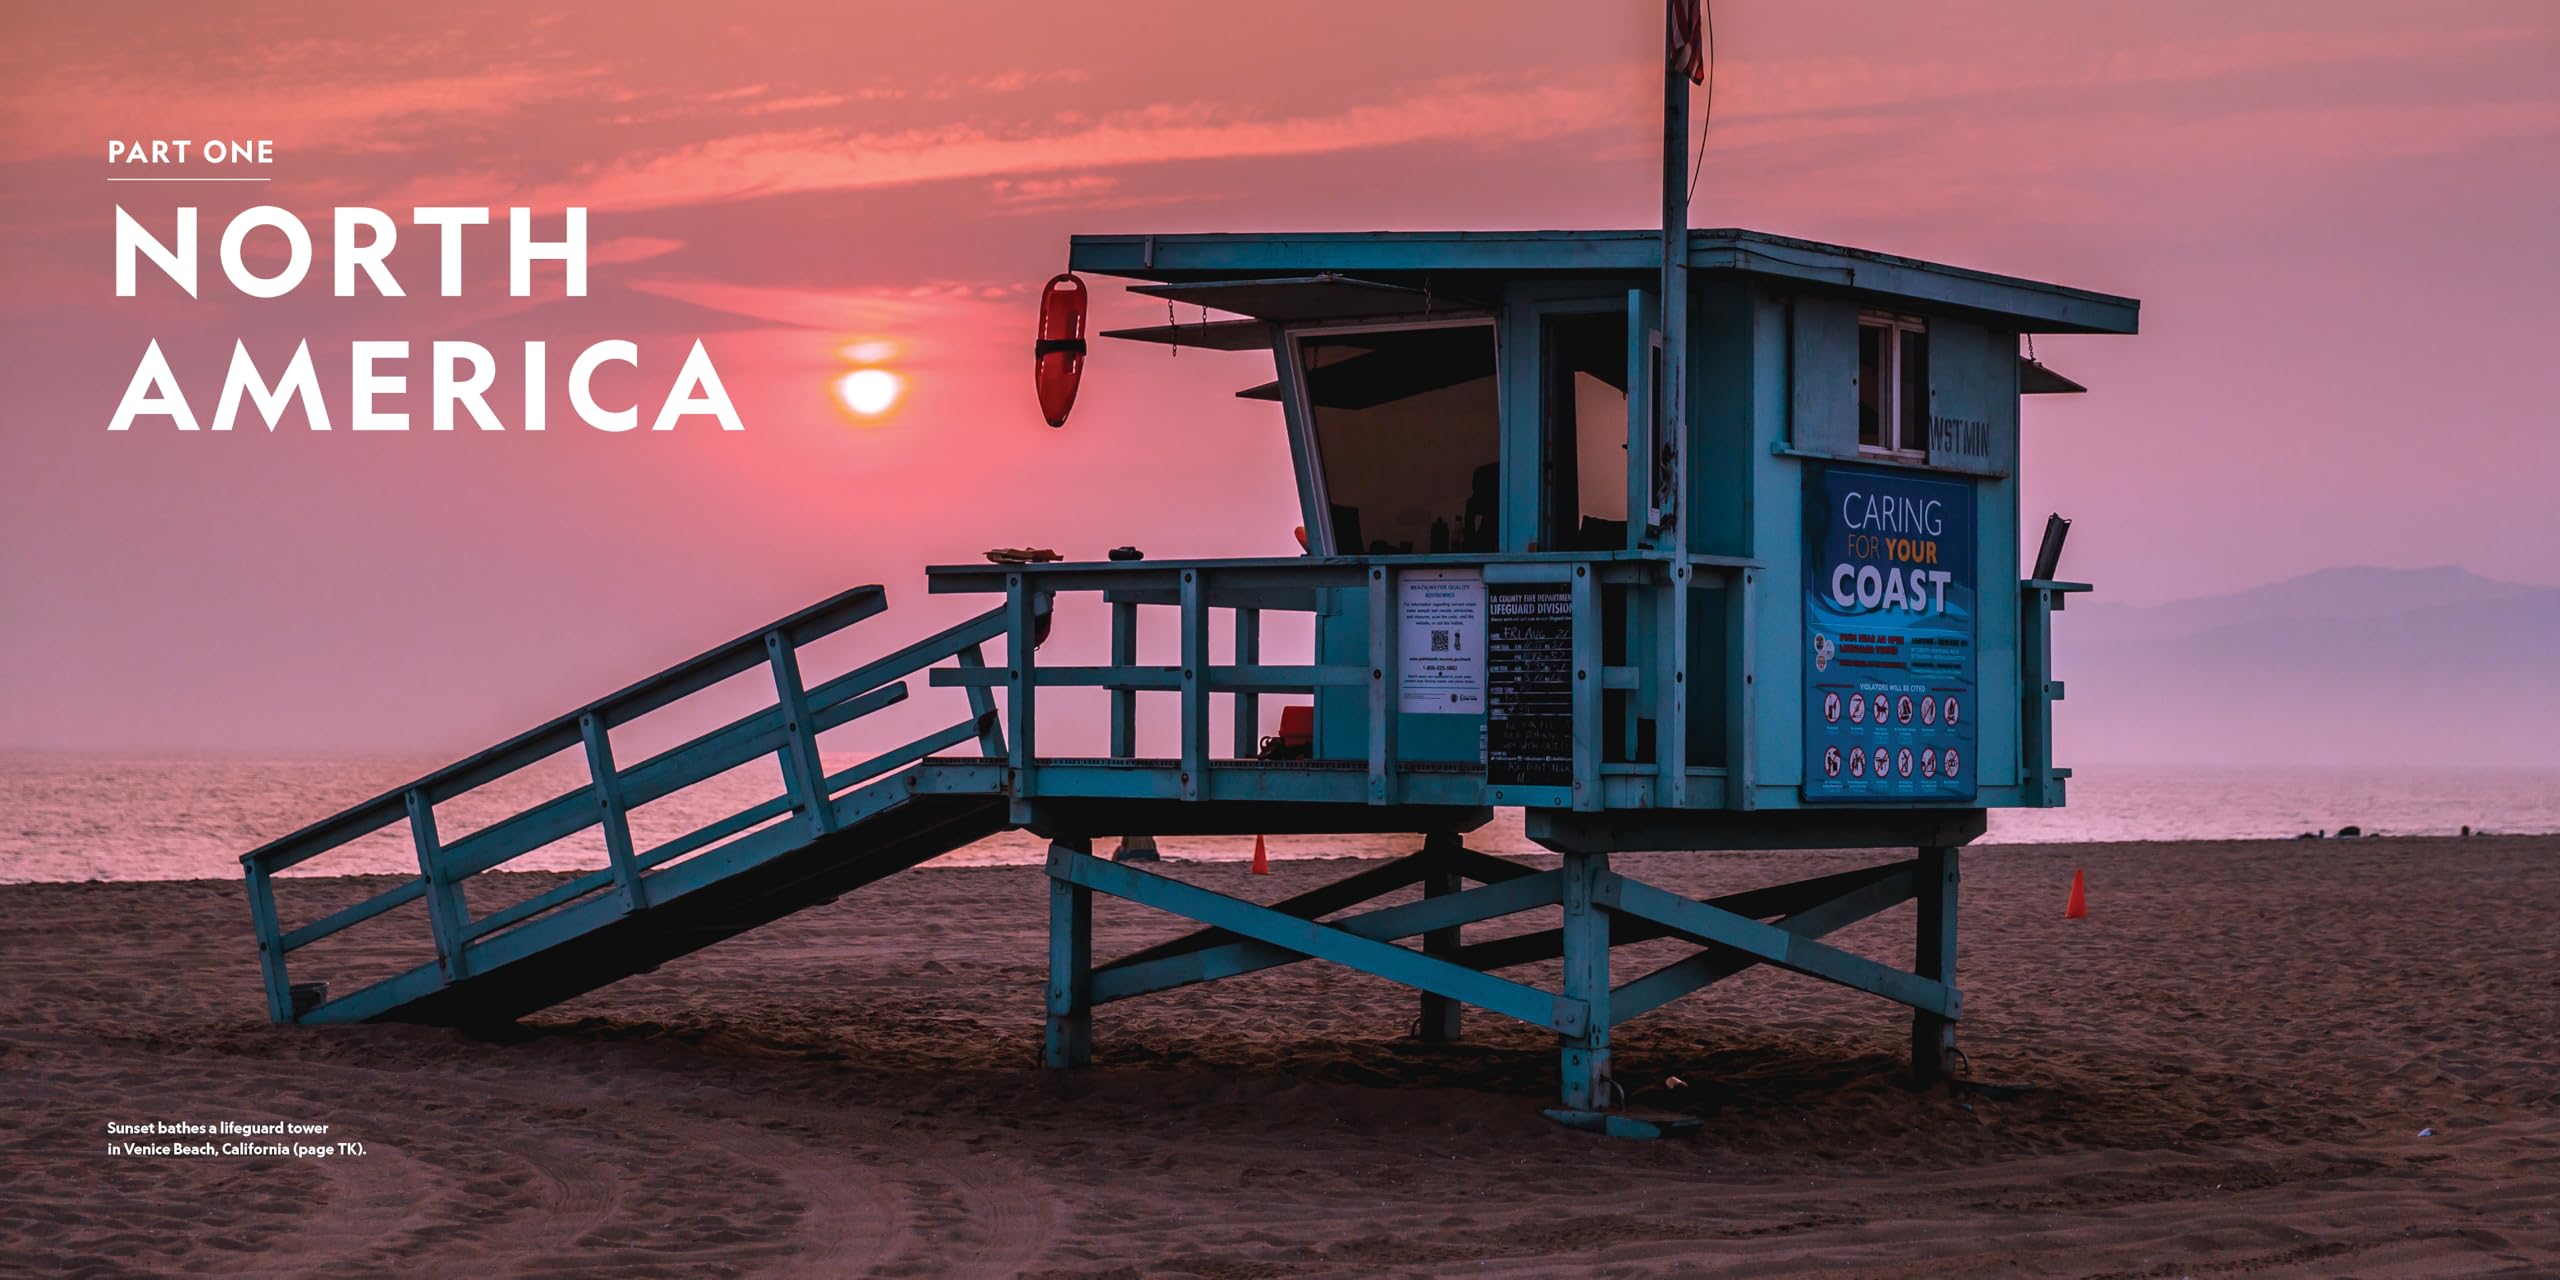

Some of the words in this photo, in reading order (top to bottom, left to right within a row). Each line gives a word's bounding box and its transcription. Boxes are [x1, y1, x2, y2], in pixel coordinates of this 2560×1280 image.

[1929, 416, 1989, 457] WSTMIN
[1843, 491, 1942, 536] CARING
[1848, 534, 1880, 560] FOR
[1885, 537, 1938, 565] YOUR
[1499, 594, 1522, 603] COUNTY
[1537, 593, 1572, 602] DEPARTMEN
[1831, 563, 1952, 613] COAST
[1490, 603, 1535, 615] LIFEGUARD
[1859, 683, 1889, 691] VIOLATORS
[1889, 684, 1902, 692] WILL
[1903, 684, 1910, 692] BE
[1910, 684, 1926, 692] CITED
